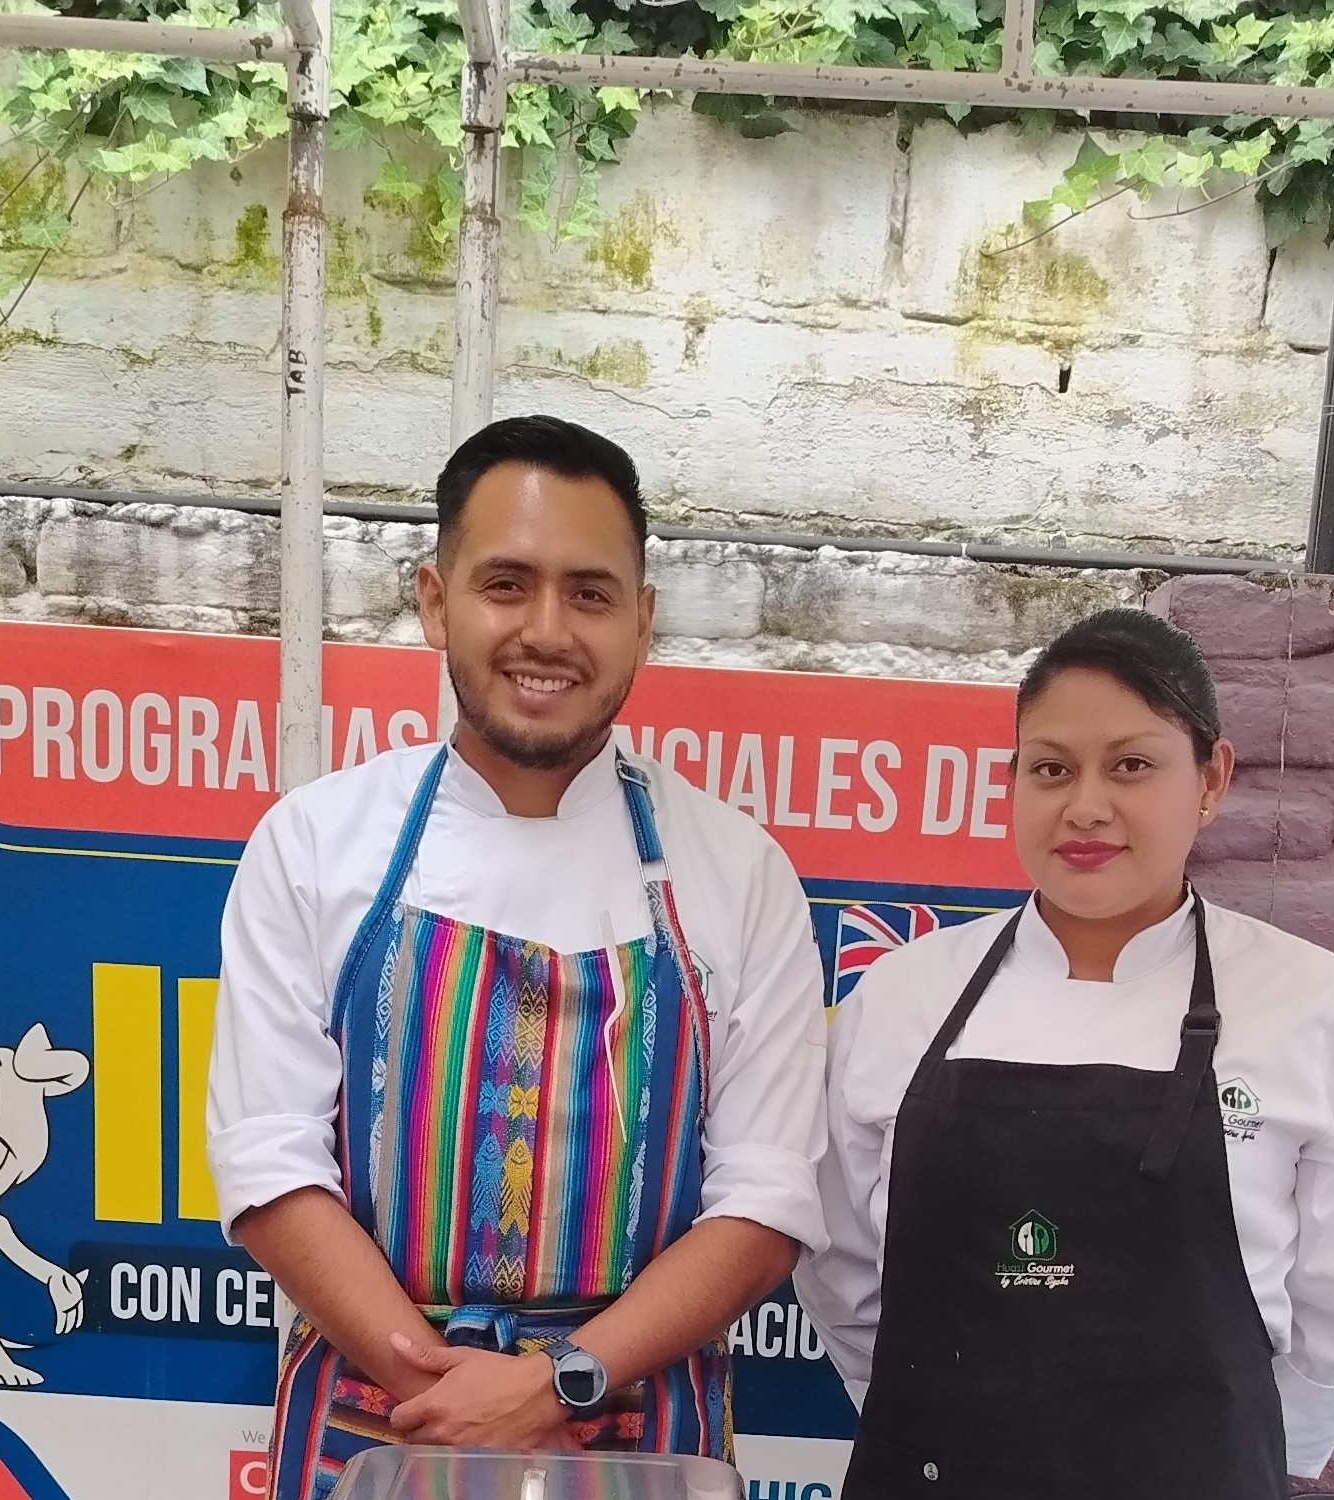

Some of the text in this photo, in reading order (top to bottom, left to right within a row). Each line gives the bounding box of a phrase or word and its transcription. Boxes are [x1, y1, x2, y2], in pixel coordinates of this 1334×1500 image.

[921, 744, 1017, 839] DE
[1027, 1262, 1075, 1273] Gourmet
[110, 1262, 201, 1324] CON
[242, 1430, 266, 1444] We
